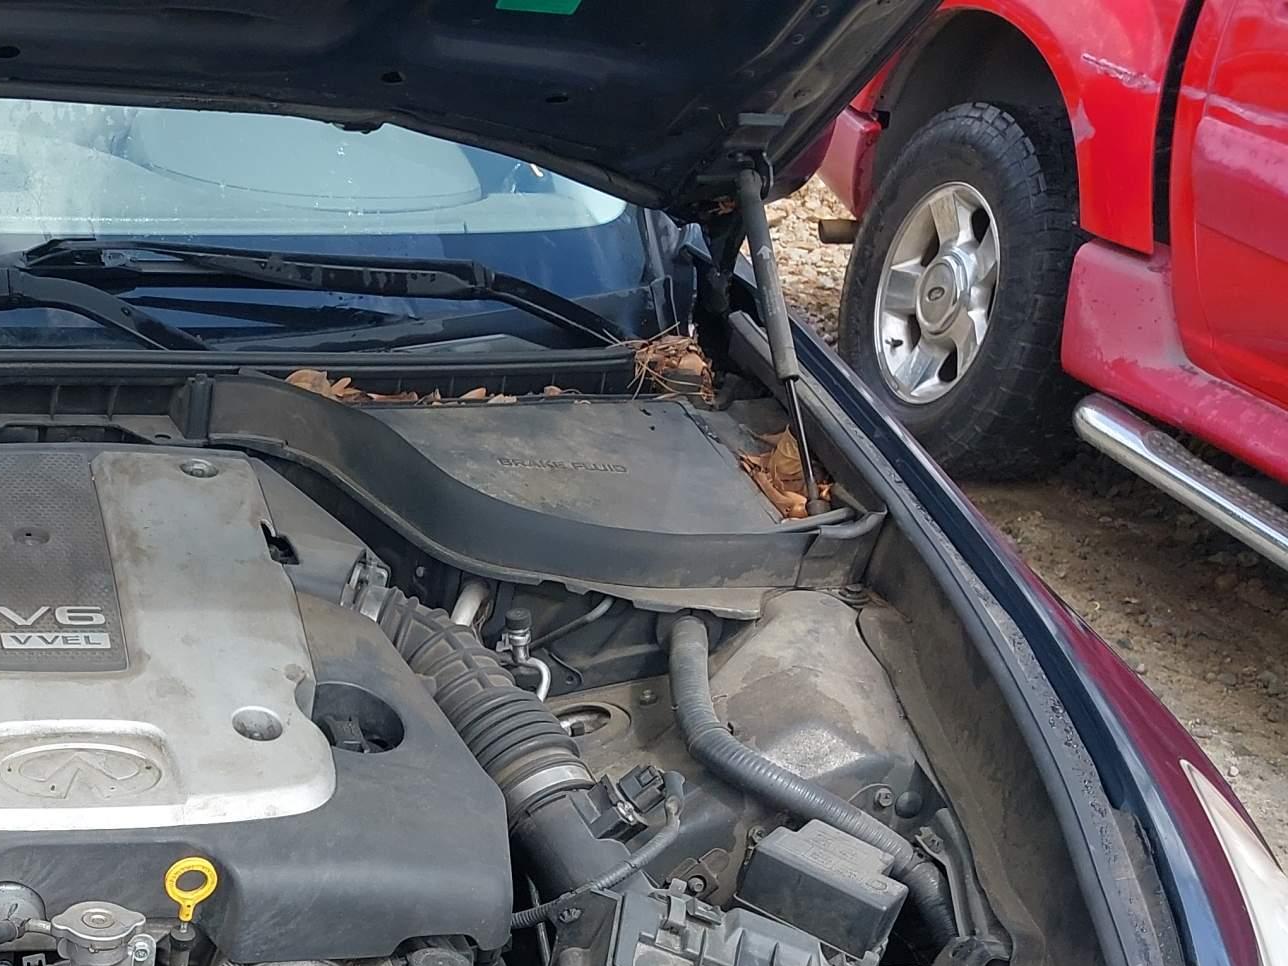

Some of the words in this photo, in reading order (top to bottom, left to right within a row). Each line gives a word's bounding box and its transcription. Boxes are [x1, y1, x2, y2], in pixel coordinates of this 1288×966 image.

[496, 458, 568, 471] BRAKE
[570, 462, 629, 473] FLUID
[10, 635, 101, 645] VVEL
